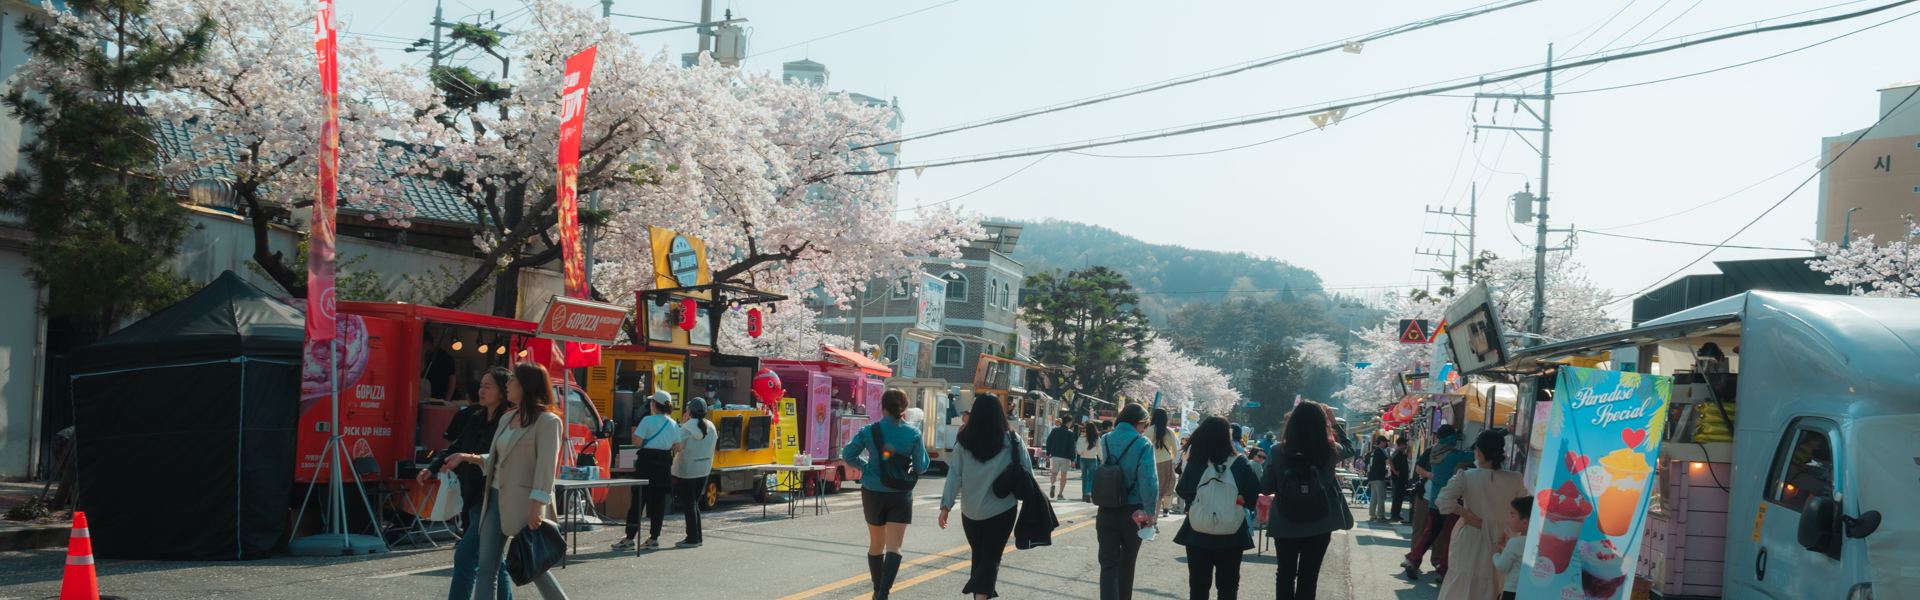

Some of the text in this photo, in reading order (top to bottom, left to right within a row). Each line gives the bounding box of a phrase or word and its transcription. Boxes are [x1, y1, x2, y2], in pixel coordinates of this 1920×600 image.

[1873, 154, 1891, 172] 시
[566, 312, 600, 332] GOPIZZA
[355, 384, 386, 400] GOPIZZA
[1571, 384, 1635, 409] Paradise
[1591, 397, 1652, 428] Special
[343, 426, 391, 437] PICK UP HERE
